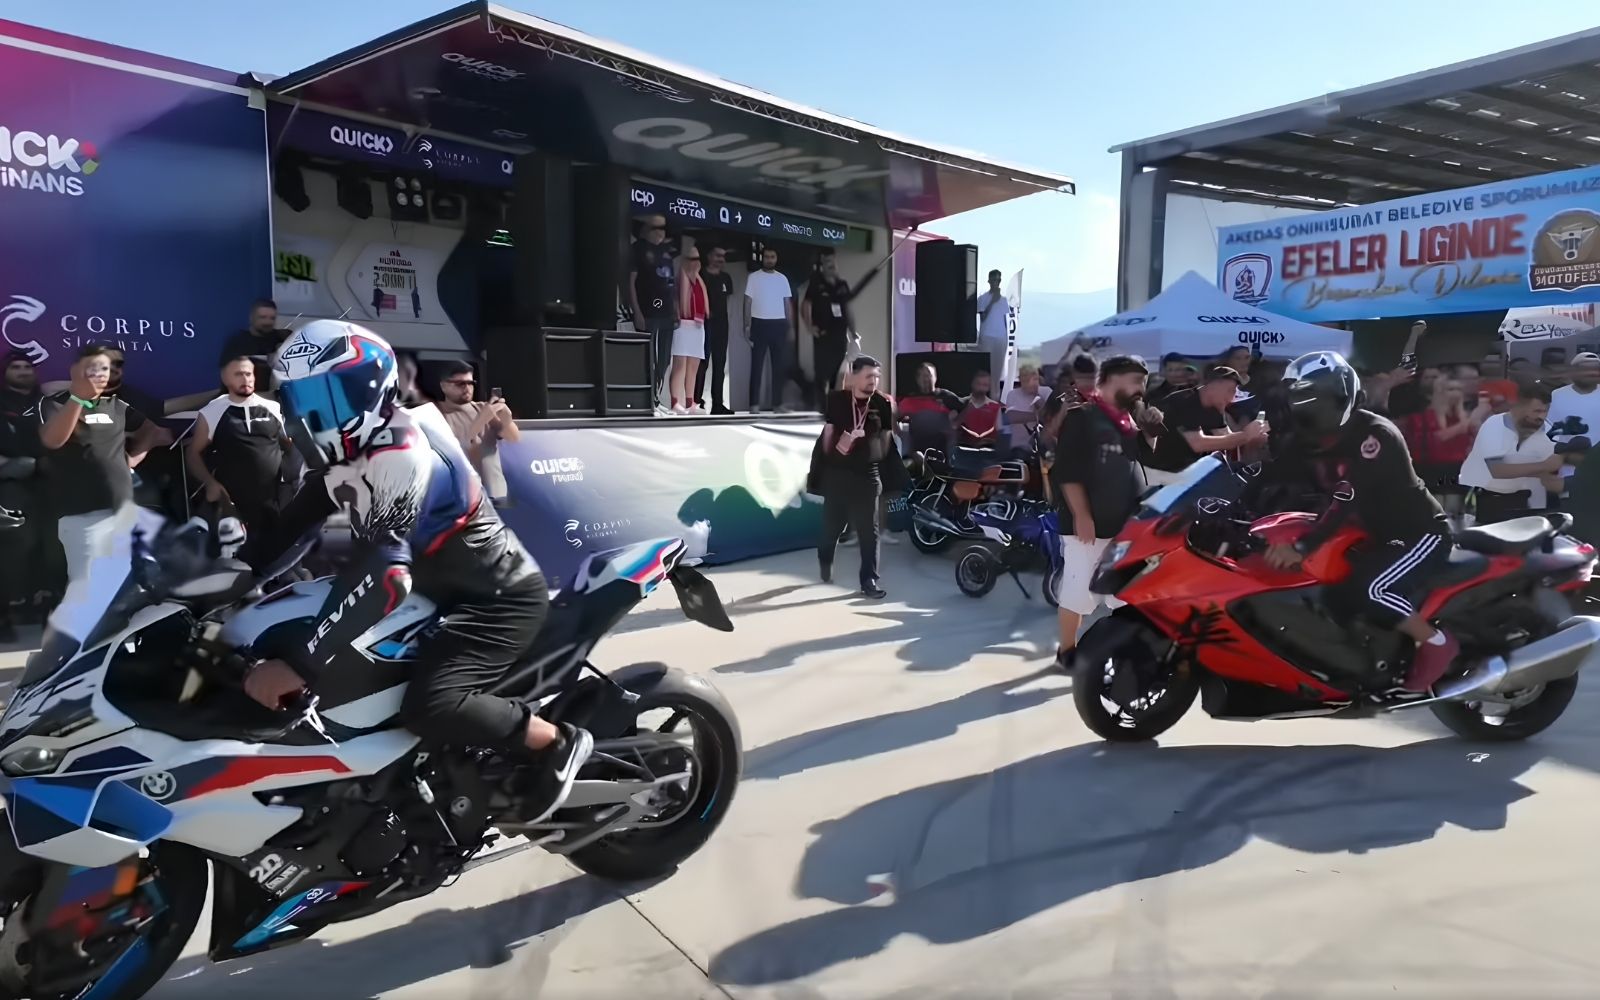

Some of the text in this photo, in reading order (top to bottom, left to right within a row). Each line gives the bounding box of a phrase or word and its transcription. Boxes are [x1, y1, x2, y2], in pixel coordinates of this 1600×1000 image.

[330, 125, 387, 153] QUICK
[612, 117, 891, 189] QUICK
[0, 166, 84, 196] iNANS
[1281, 233, 1387, 280] EFELER
[61, 314, 195, 338] CORPUS
[1238, 331, 1279, 344] QUICK
